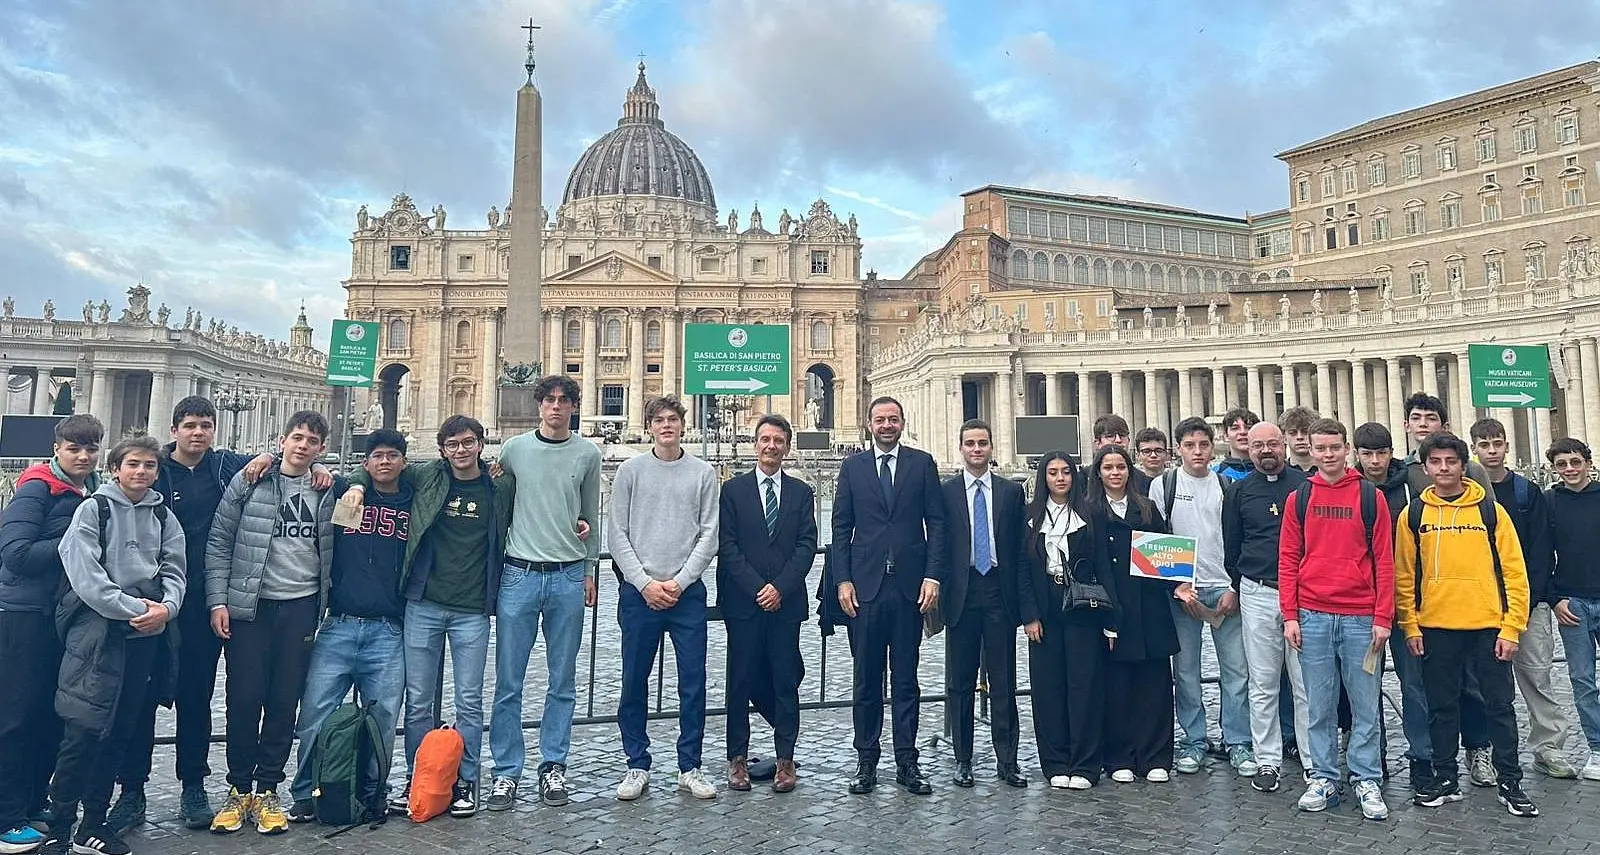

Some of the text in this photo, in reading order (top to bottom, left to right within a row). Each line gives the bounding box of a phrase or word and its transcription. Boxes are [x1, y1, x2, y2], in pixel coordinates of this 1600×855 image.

[694, 352, 781, 360] BASILICA DI SAN PIETRO
[697, 364, 777, 373] ST. PETER'S BASILICA
[1312, 505, 1353, 520] PUMA
[343, 505, 411, 541] 953
[1419, 523, 1487, 534] Champion
[1144, 543, 1184, 553] TRENTINO
[1152, 551, 1174, 560] ALTO
[1150, 559, 1176, 569] ADIGE
